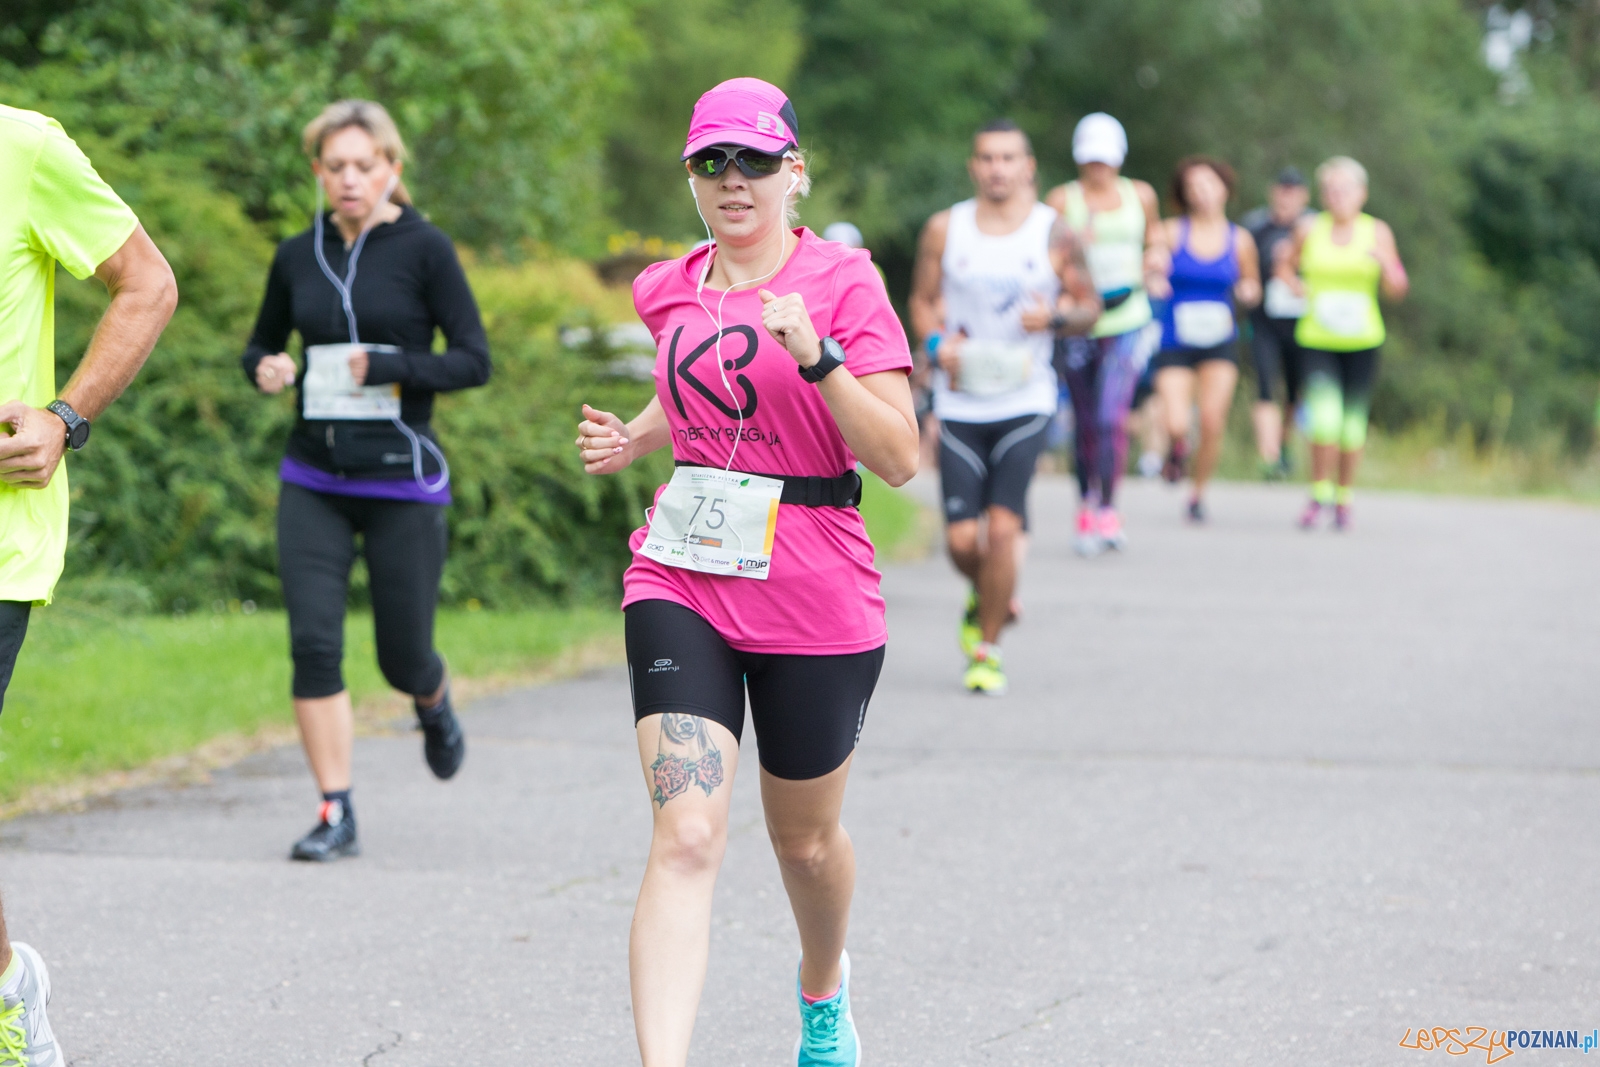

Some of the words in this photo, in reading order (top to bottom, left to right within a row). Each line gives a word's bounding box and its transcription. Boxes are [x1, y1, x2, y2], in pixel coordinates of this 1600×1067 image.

[688, 495, 725, 530] 75
[715, 558, 730, 566] more
[745, 558, 768, 569] mjp
